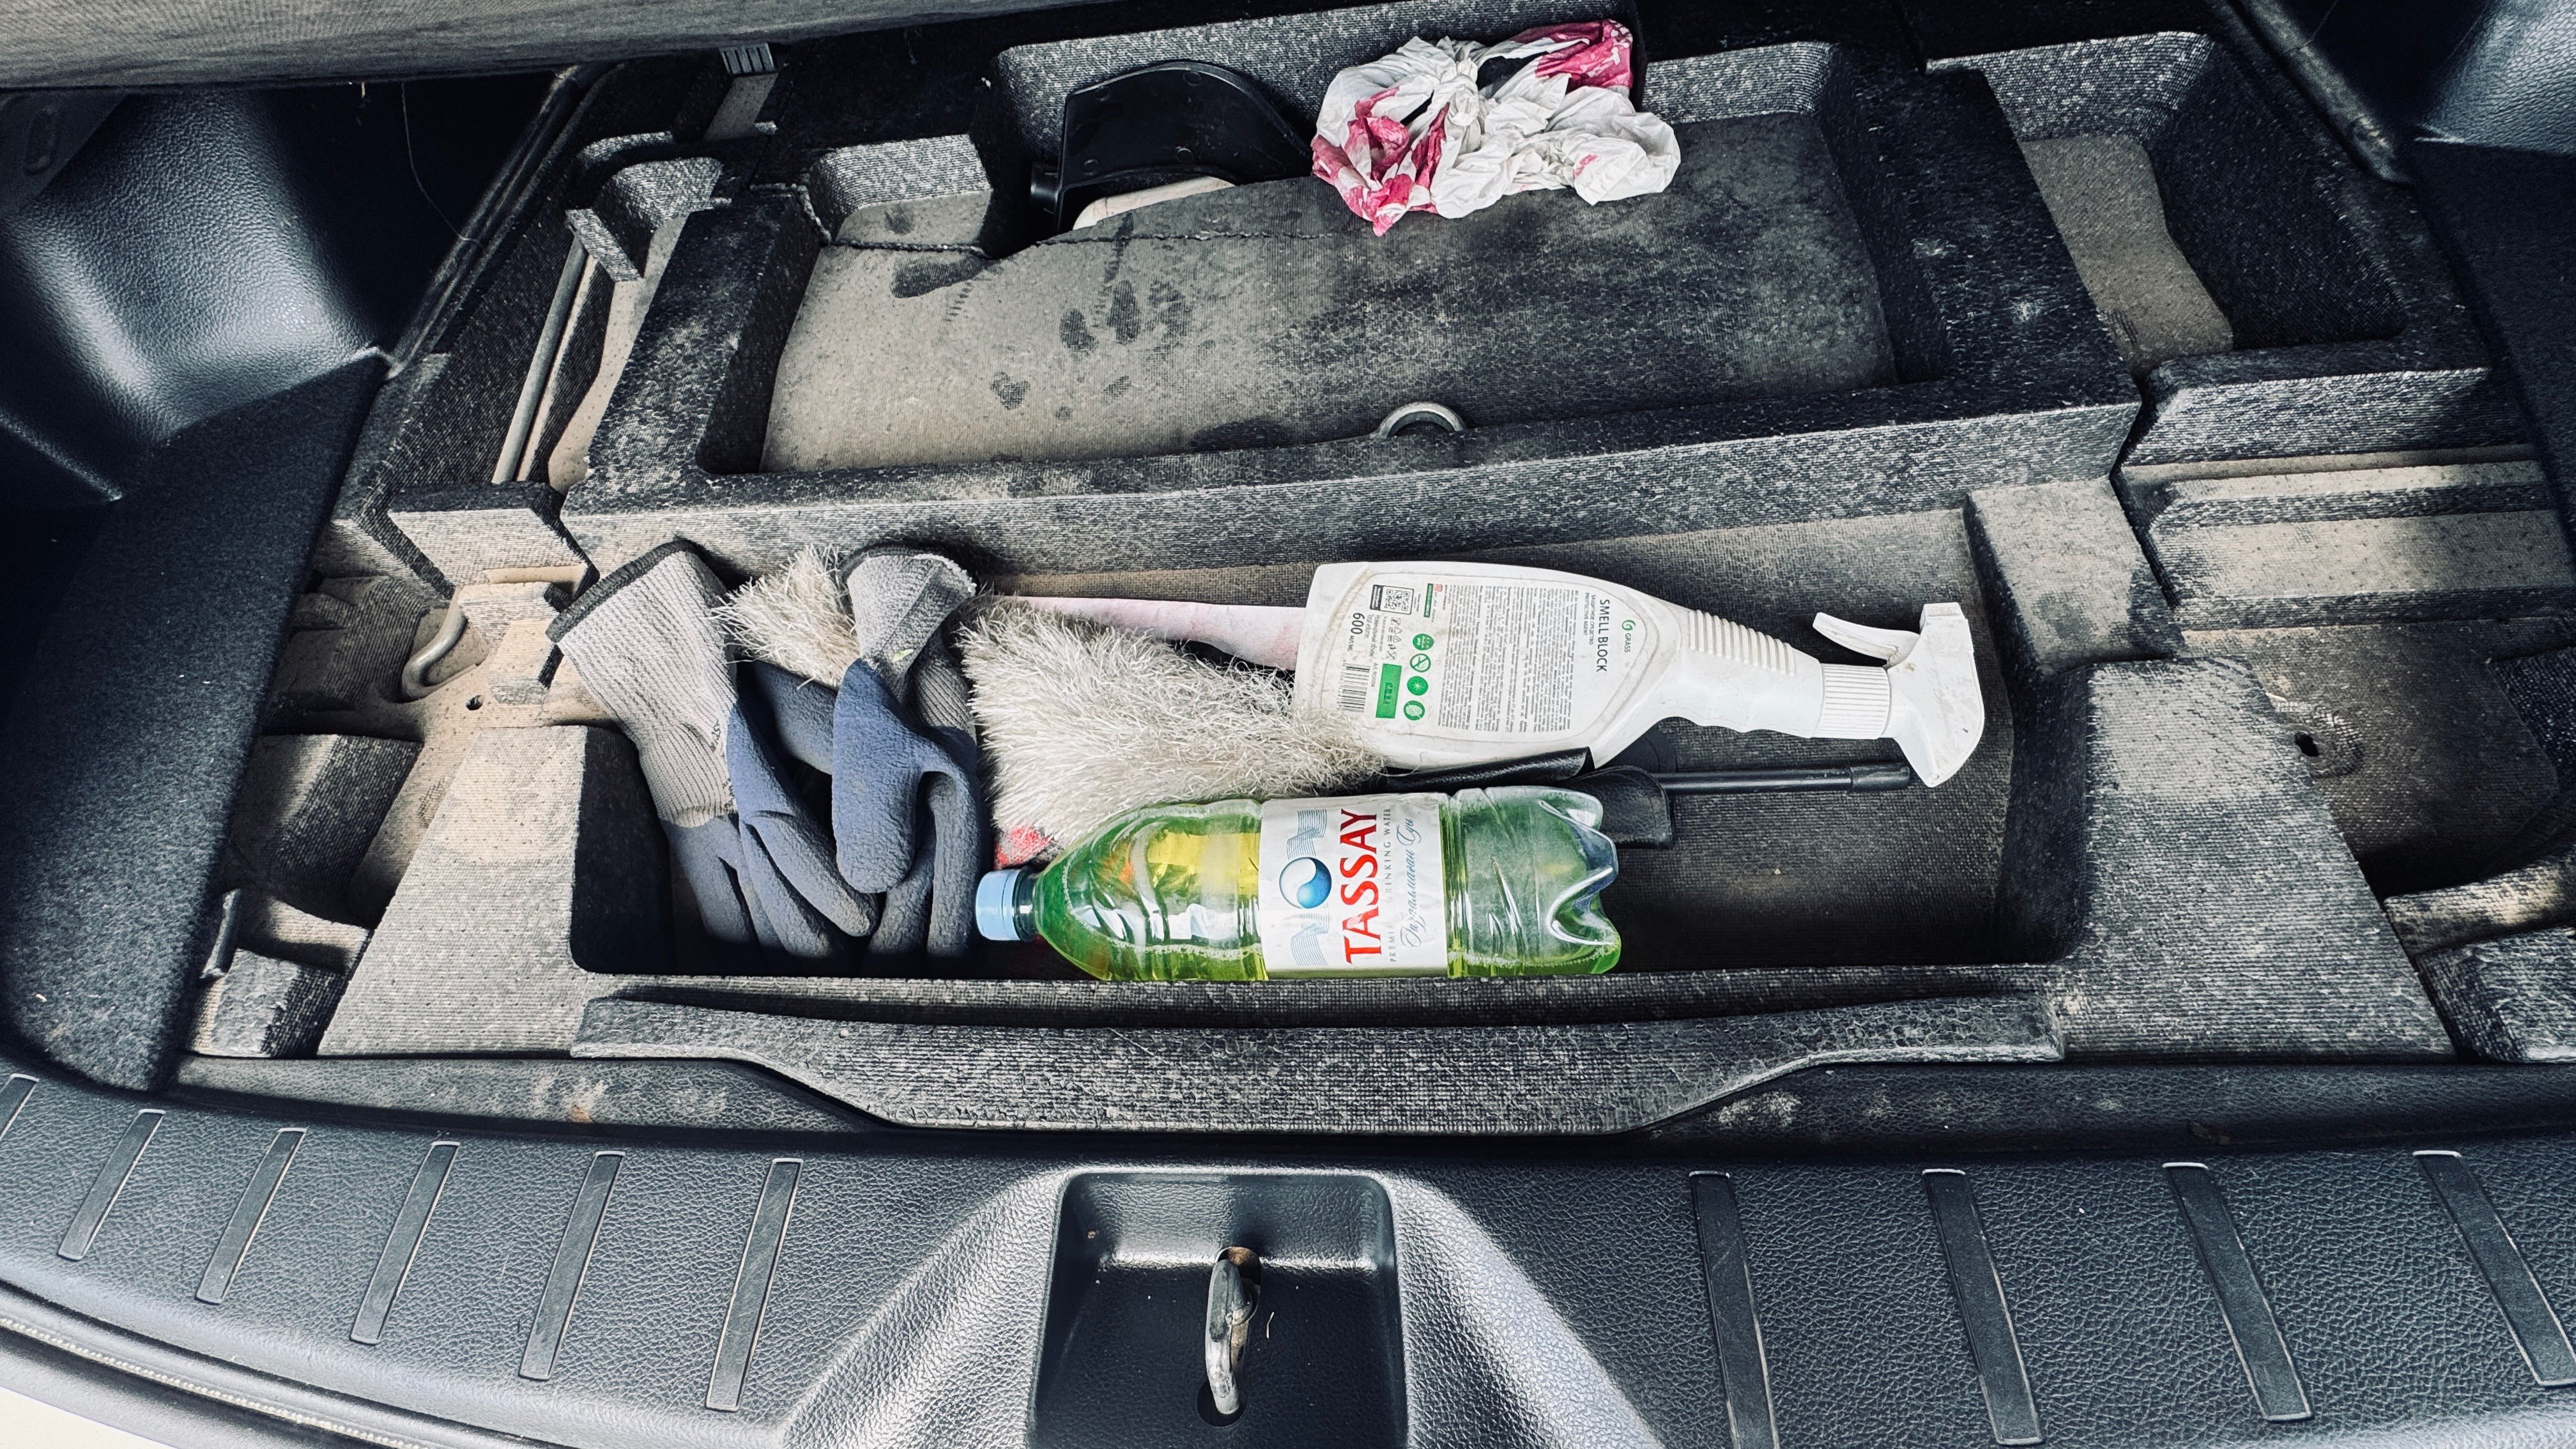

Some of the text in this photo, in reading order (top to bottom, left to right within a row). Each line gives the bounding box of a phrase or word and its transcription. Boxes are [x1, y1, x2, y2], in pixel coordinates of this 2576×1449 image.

[1351, 613, 1365, 634] 600
[1596, 599, 1610, 673] SMELL BLOCK
[1383, 808, 1392, 836] WATER
[1340, 808, 1382, 965] TASSAY
